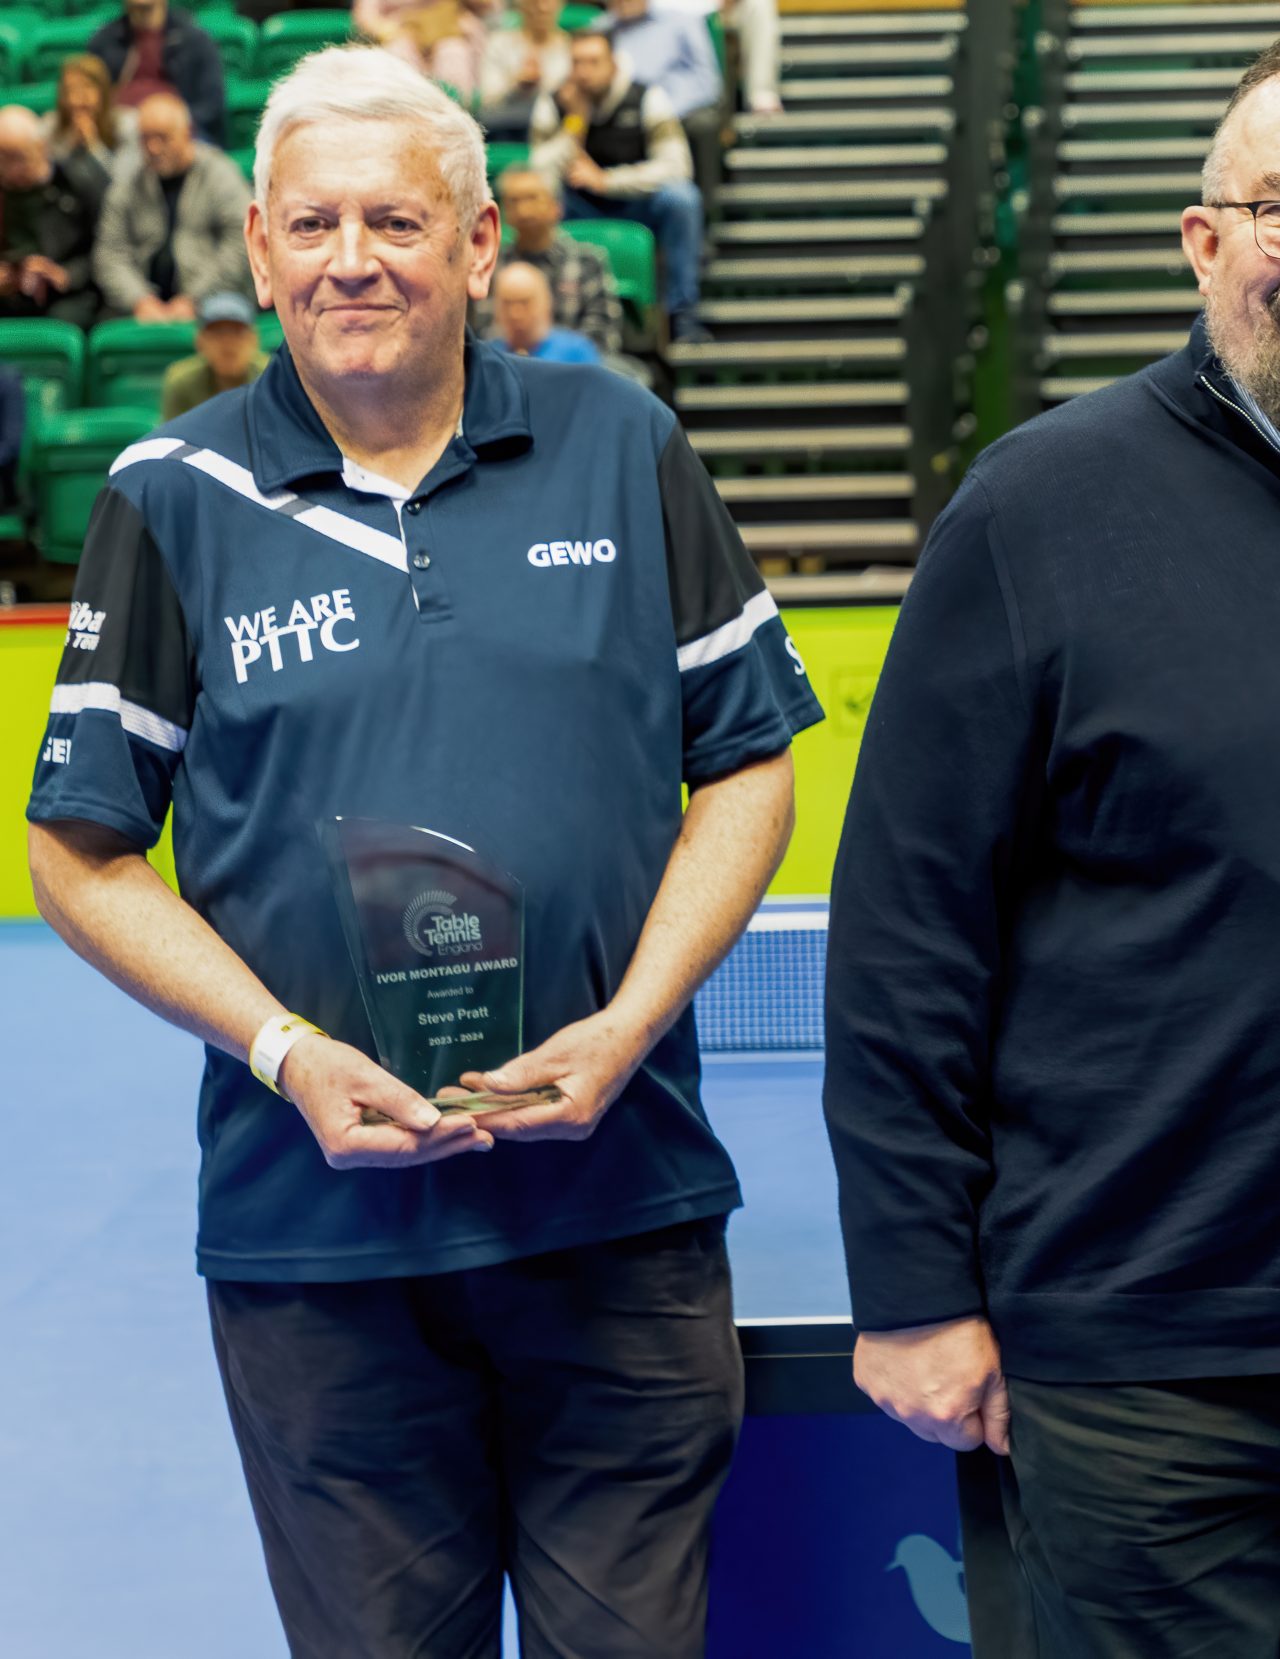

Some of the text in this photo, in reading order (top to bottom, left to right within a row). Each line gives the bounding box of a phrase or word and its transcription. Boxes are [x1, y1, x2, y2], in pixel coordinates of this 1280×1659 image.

[527, 538, 617, 567] GEWO
[224, 588, 354, 642] WE ARE
[231, 612, 360, 684] PTTC
[431, 912, 480, 932] Table
[424, 927, 481, 946] Tennis
[376, 957, 518, 984] IVOR MONTAGU AWARD
[427, 986, 474, 999] Awarded to
[418, 1005, 489, 1025] Steve Pratt
[429, 1035, 453, 1046] 2023
[460, 1032, 484, 1043] 2024
